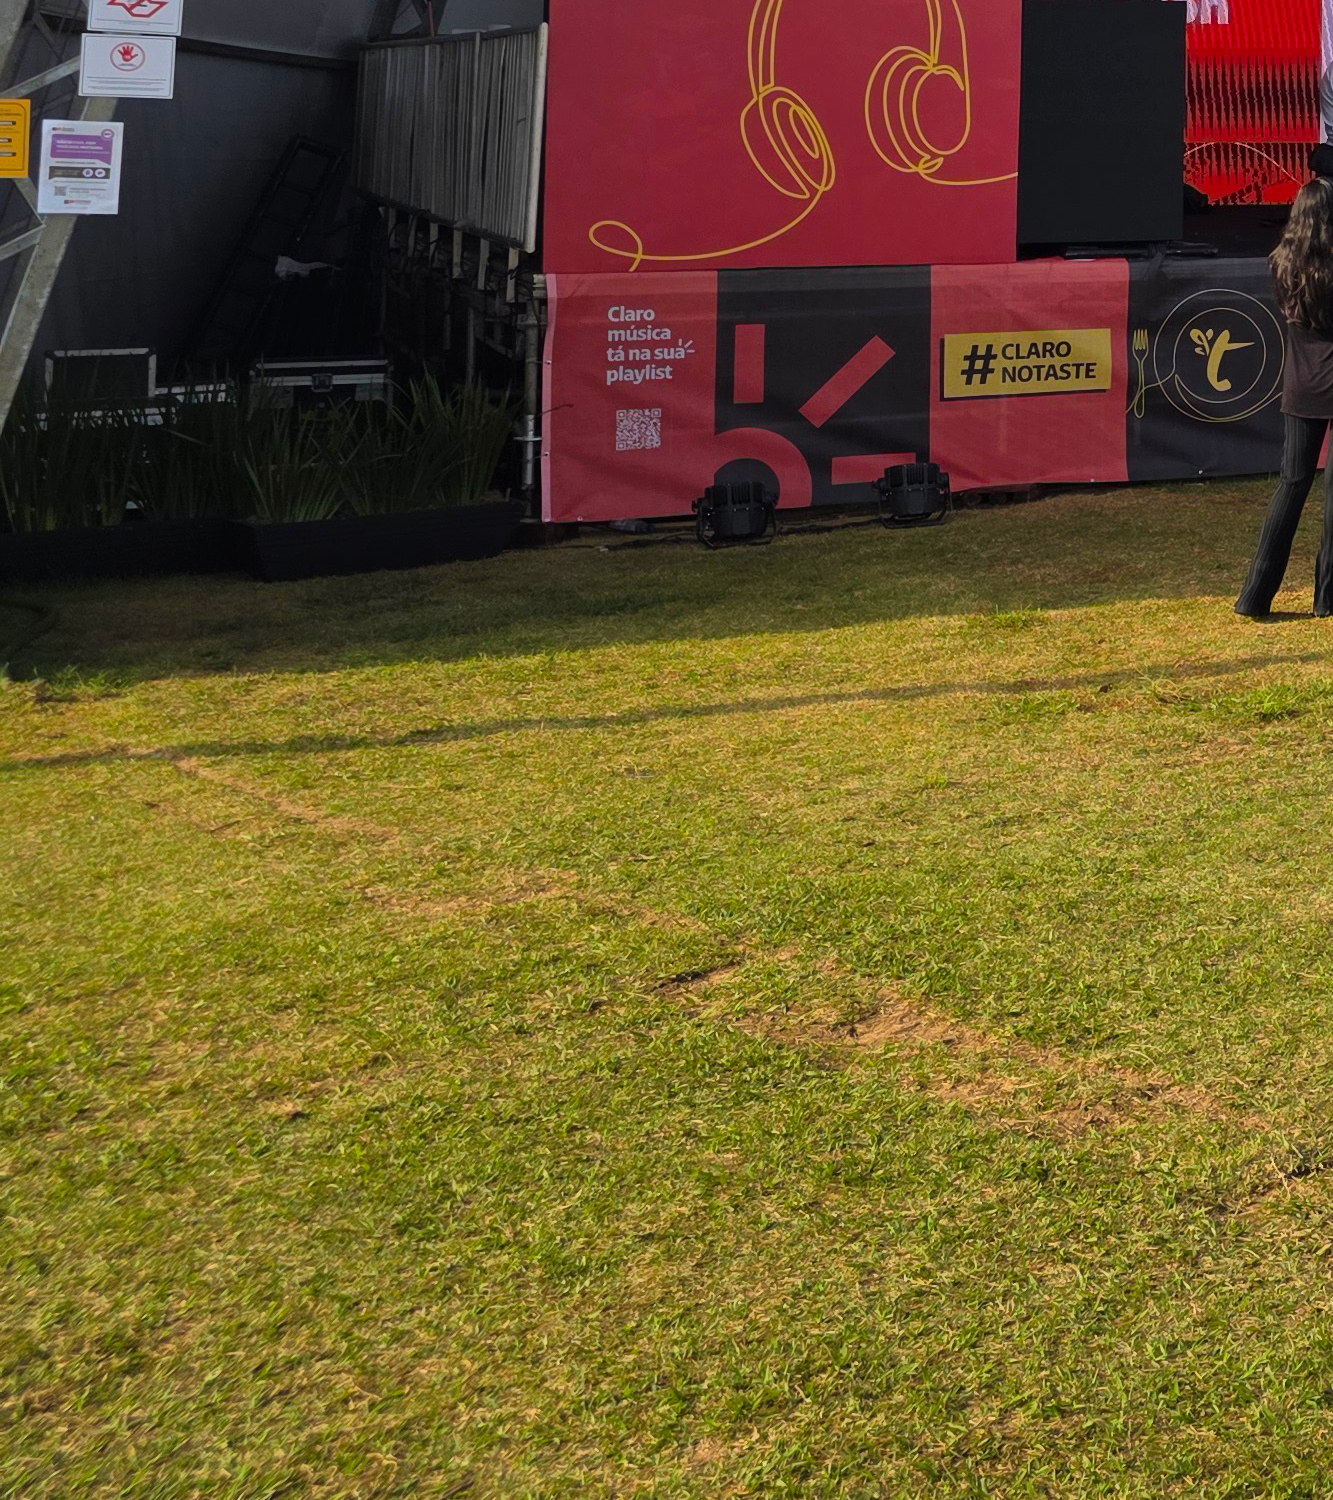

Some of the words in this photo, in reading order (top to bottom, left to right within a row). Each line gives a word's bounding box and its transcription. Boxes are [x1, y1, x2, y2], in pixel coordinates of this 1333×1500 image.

[607, 306, 655, 322] Claro
[607, 325, 671, 342] música
[606, 345, 625, 362] tá
[629, 348, 651, 361] na
[654, 346, 685, 360] sua
[606, 364, 673, 386] playlist
[1001, 362, 1097, 384] NOTASTE
